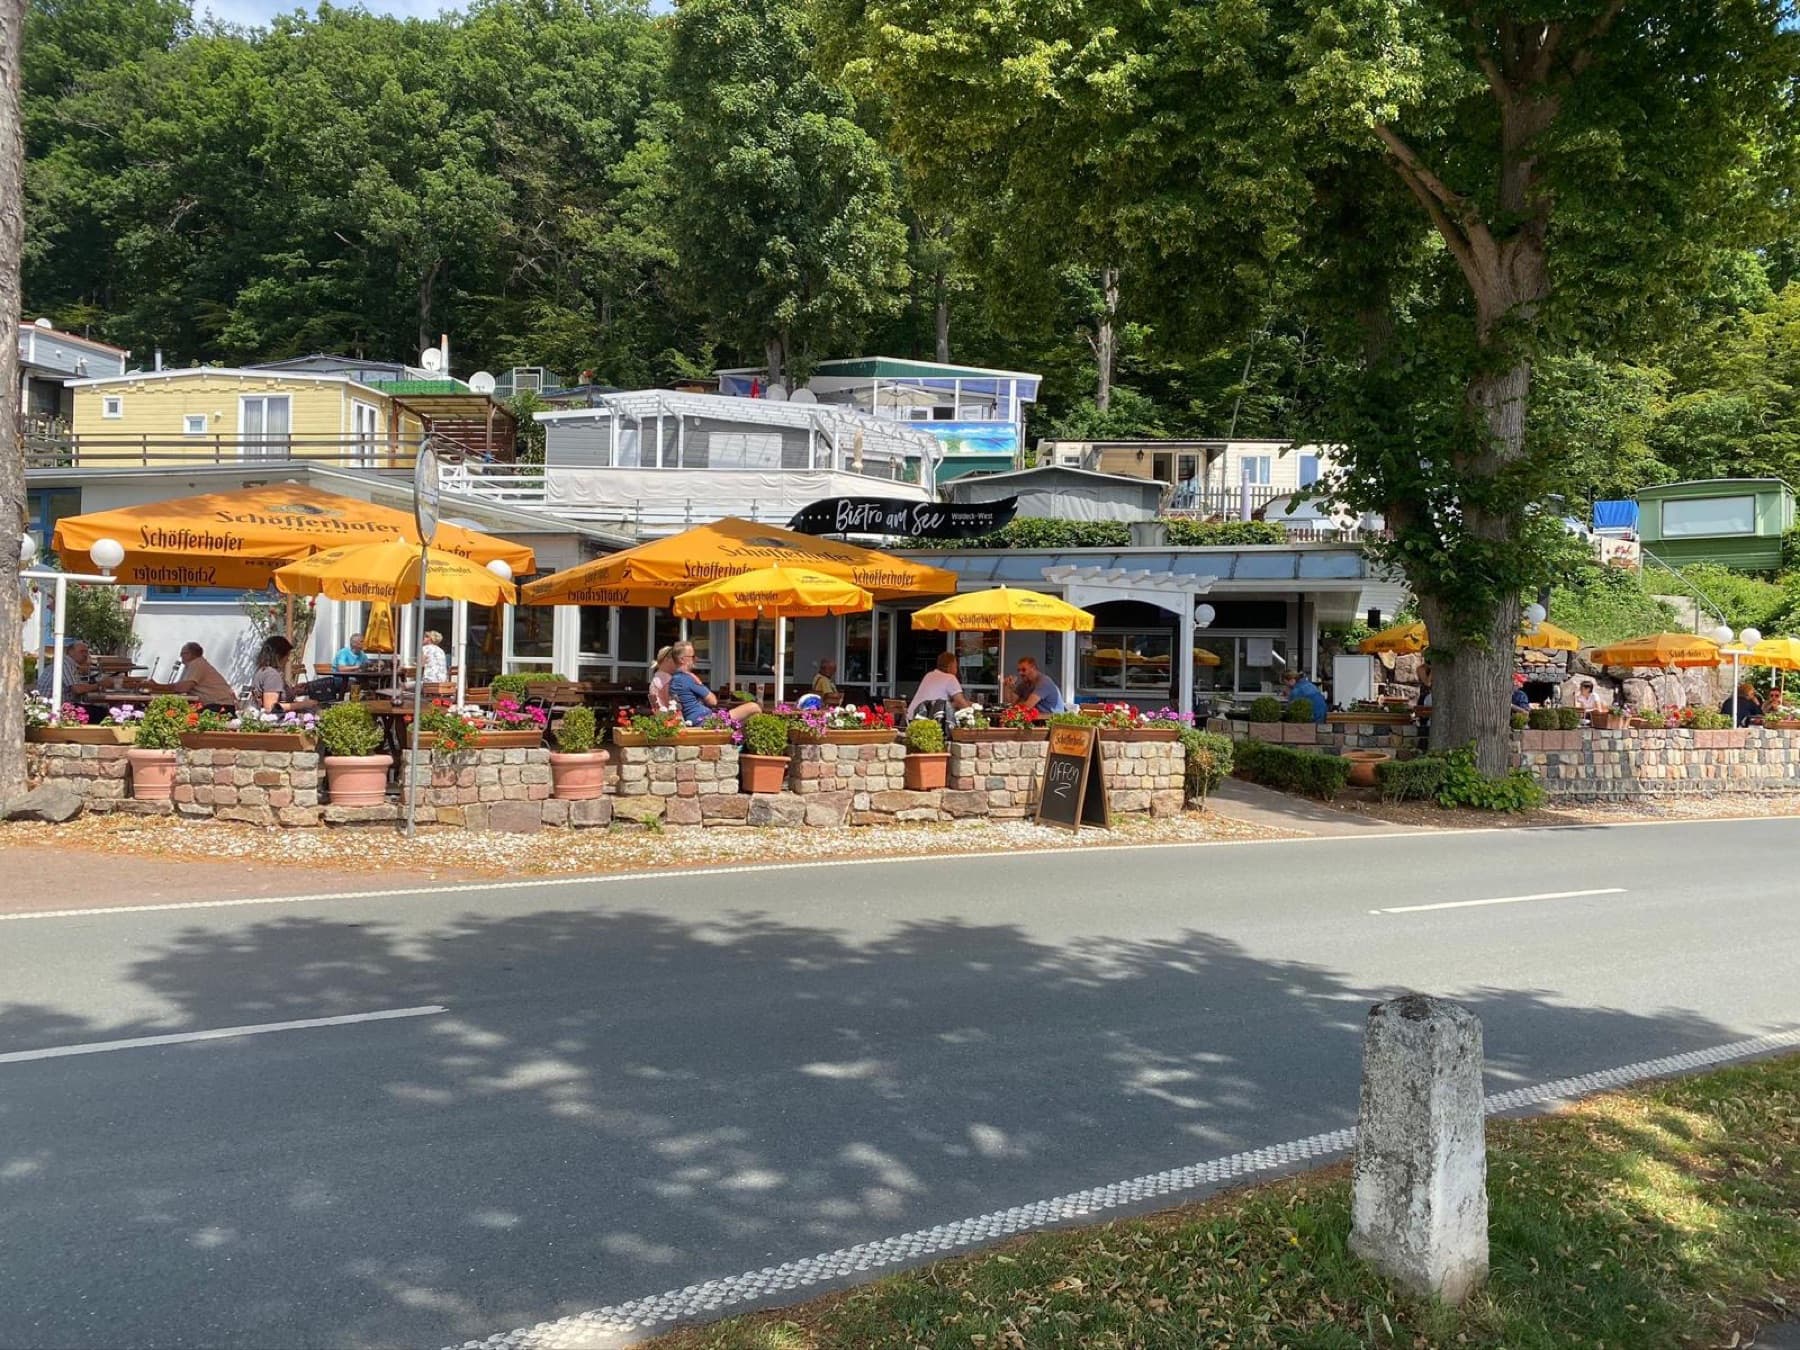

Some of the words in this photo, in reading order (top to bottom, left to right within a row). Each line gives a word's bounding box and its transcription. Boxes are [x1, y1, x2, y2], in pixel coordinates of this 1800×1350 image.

[216, 511, 401, 533] Schöfferhofer
[836, 500, 882, 531] Bistro
[887, 510, 907, 531] am
[911, 502, 945, 536] See
[138, 525, 245, 553] Schöfferhofer
[852, 567, 915, 587] Schöfferhofer
[342, 580, 396, 597] Schöfferhofer
